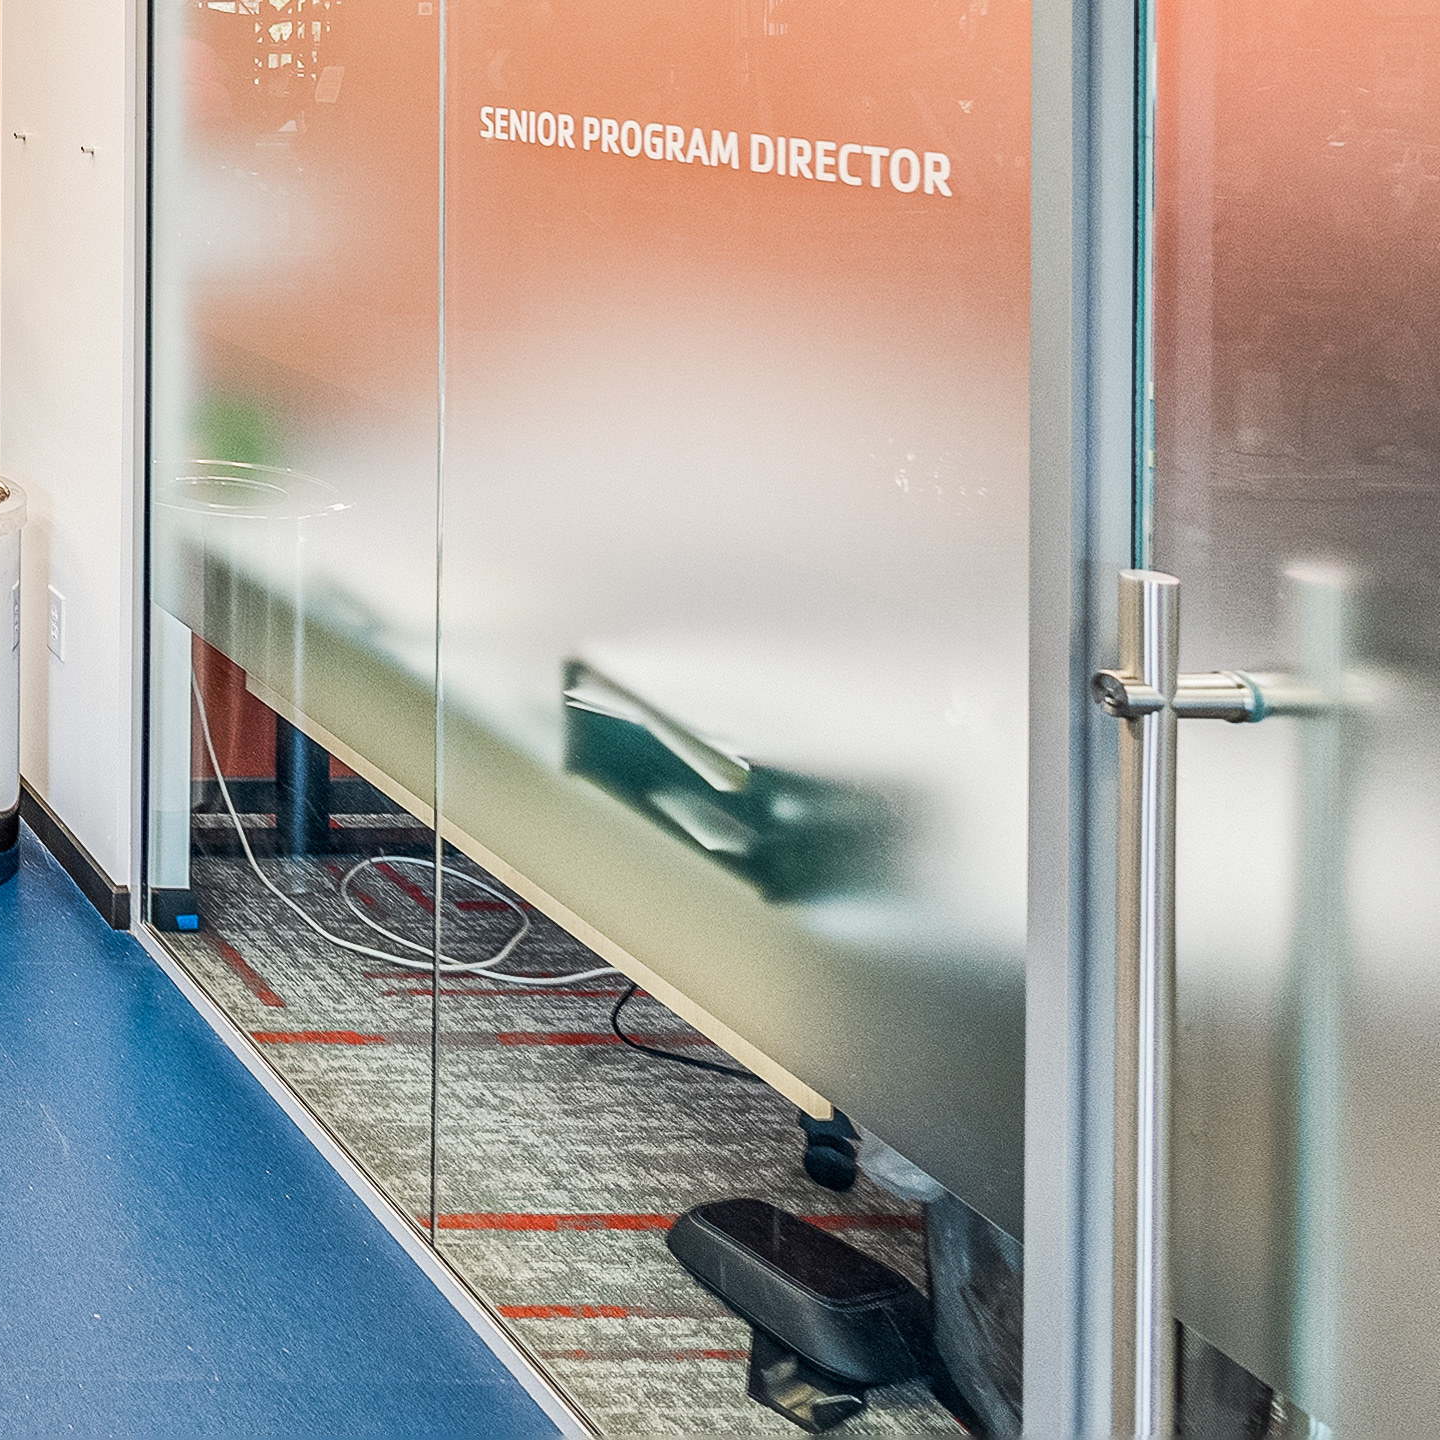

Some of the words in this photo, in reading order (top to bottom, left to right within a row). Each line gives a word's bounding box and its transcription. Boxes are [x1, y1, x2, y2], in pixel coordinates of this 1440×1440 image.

[479, 105, 575, 149] SENIOR
[582, 115, 740, 170] PROGRAM
[749, 133, 953, 197] DIRECTOR
